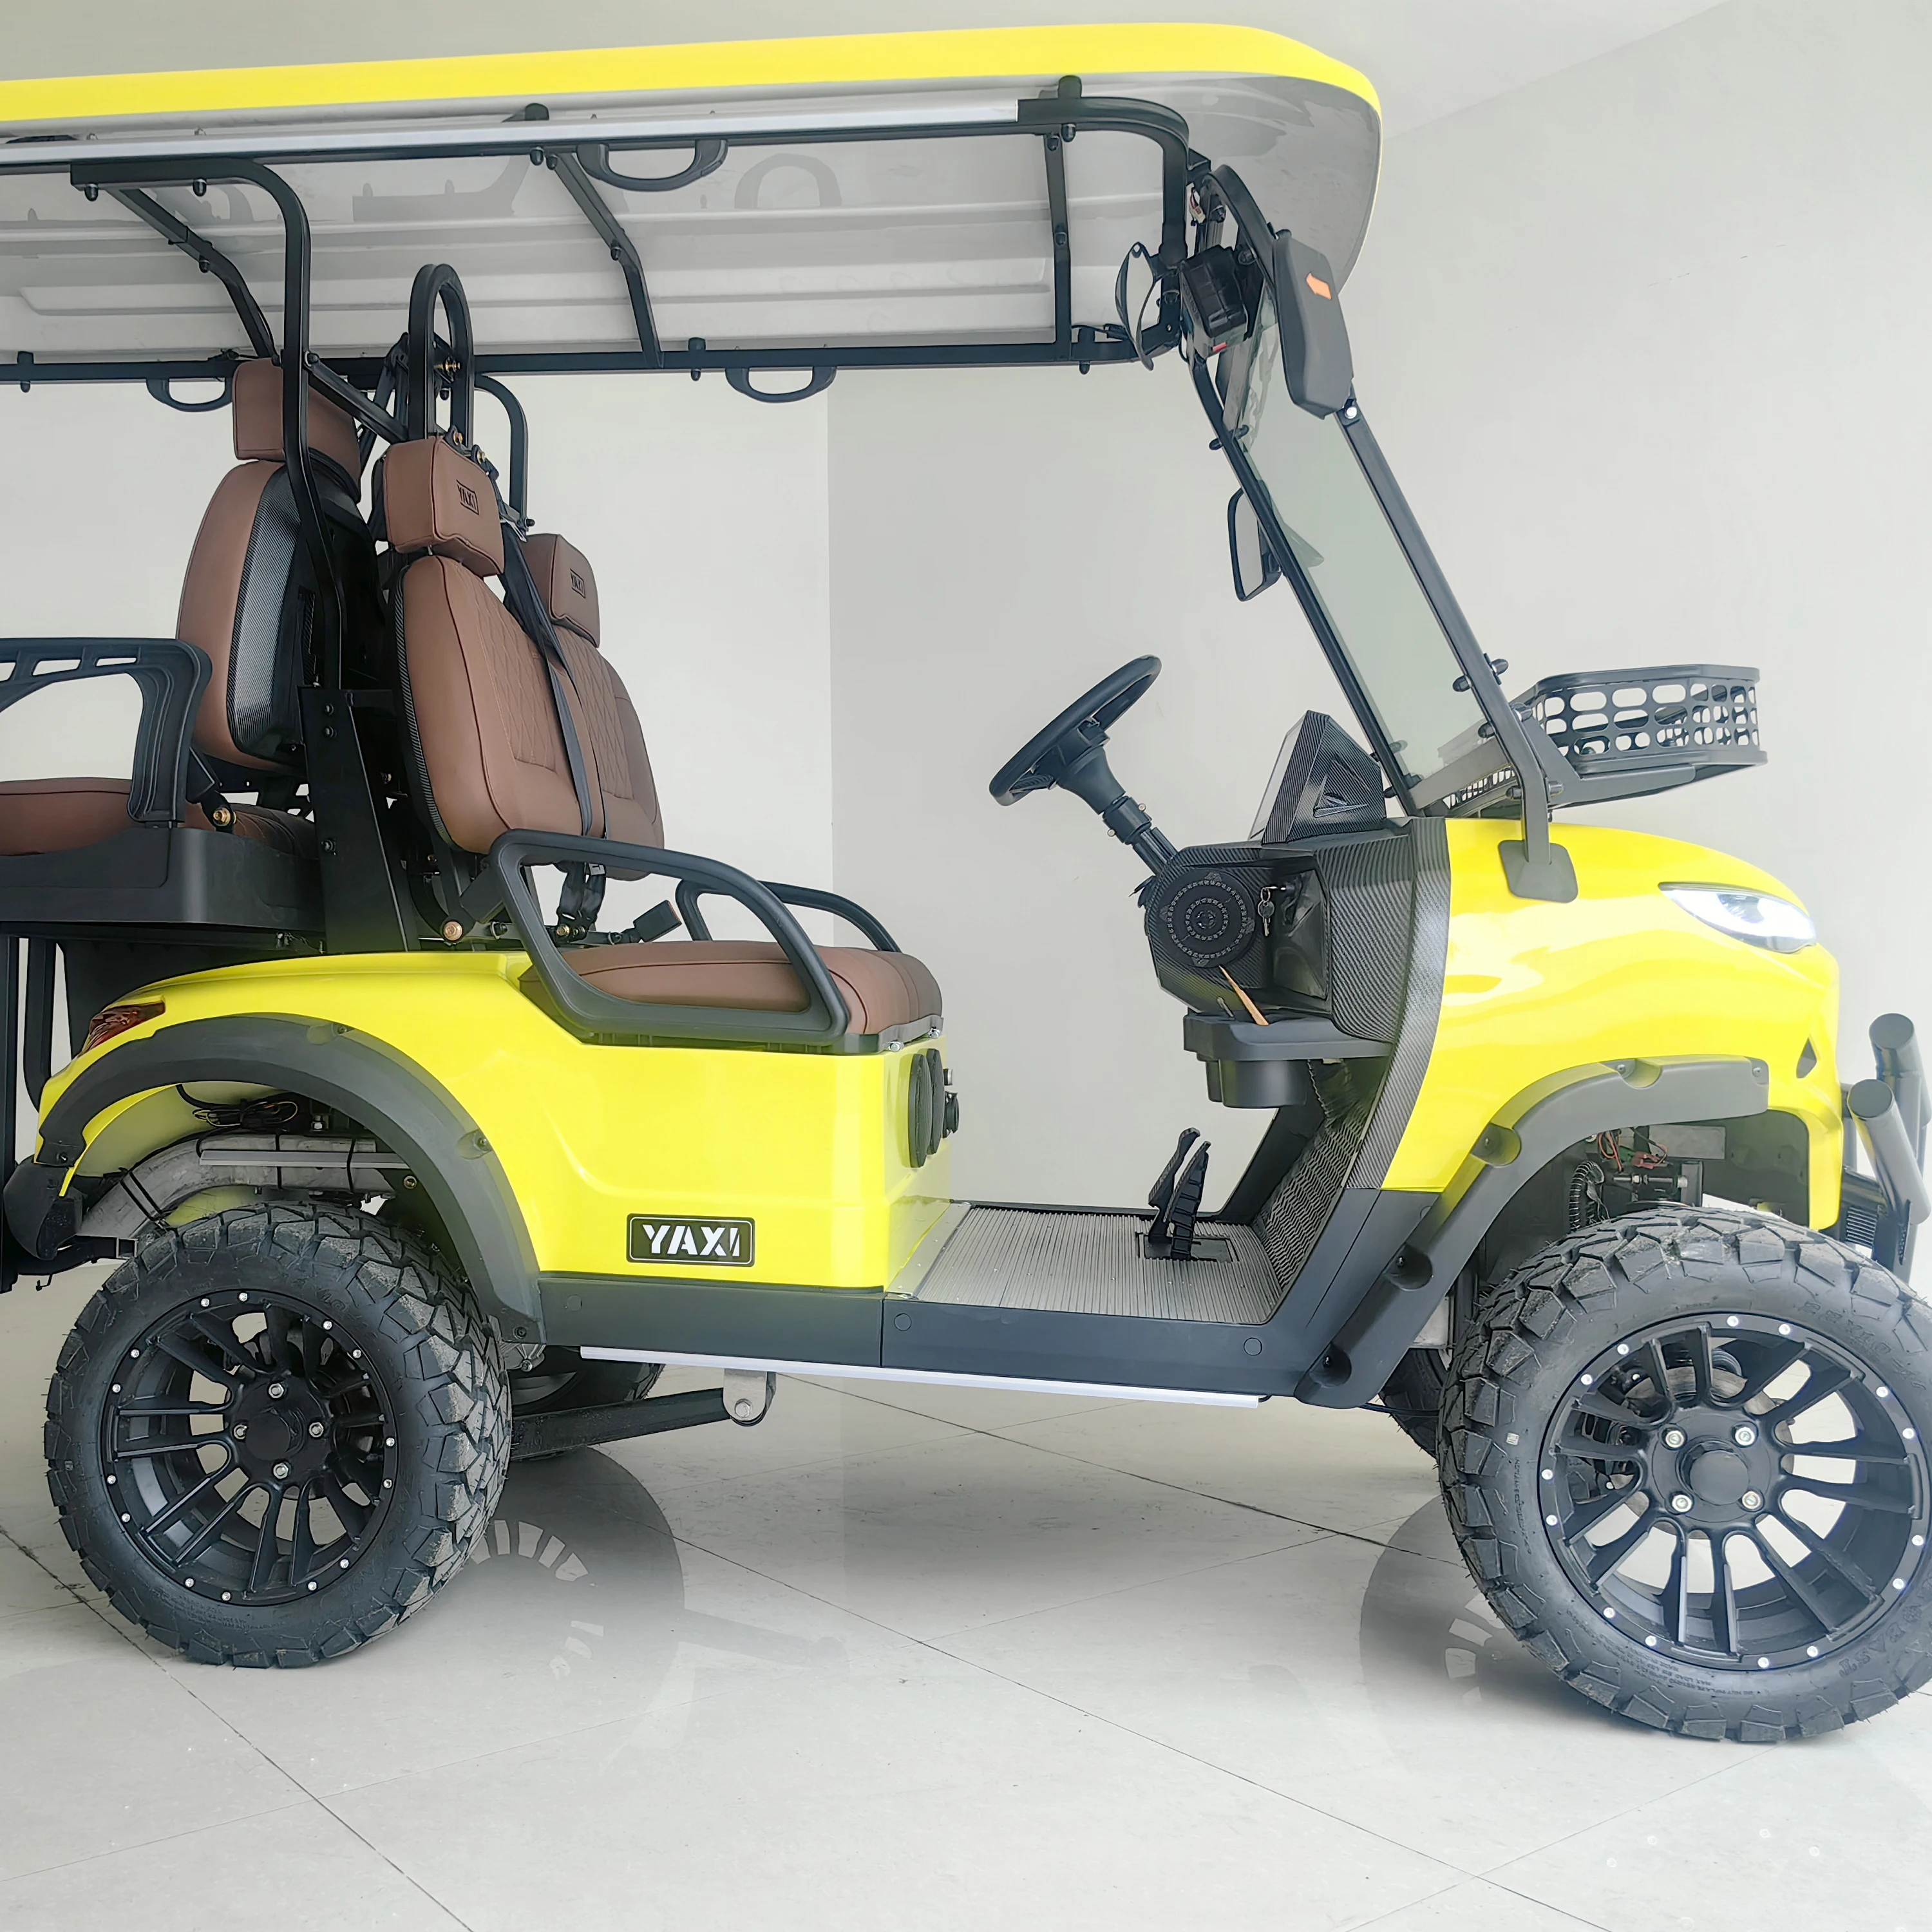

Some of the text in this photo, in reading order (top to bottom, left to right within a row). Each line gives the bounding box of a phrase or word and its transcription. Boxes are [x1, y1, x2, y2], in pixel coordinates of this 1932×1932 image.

[457, 484, 477, 510] YAXI
[570, 572, 584, 594] YAXI
[642, 1224, 739, 1257] YAXI
